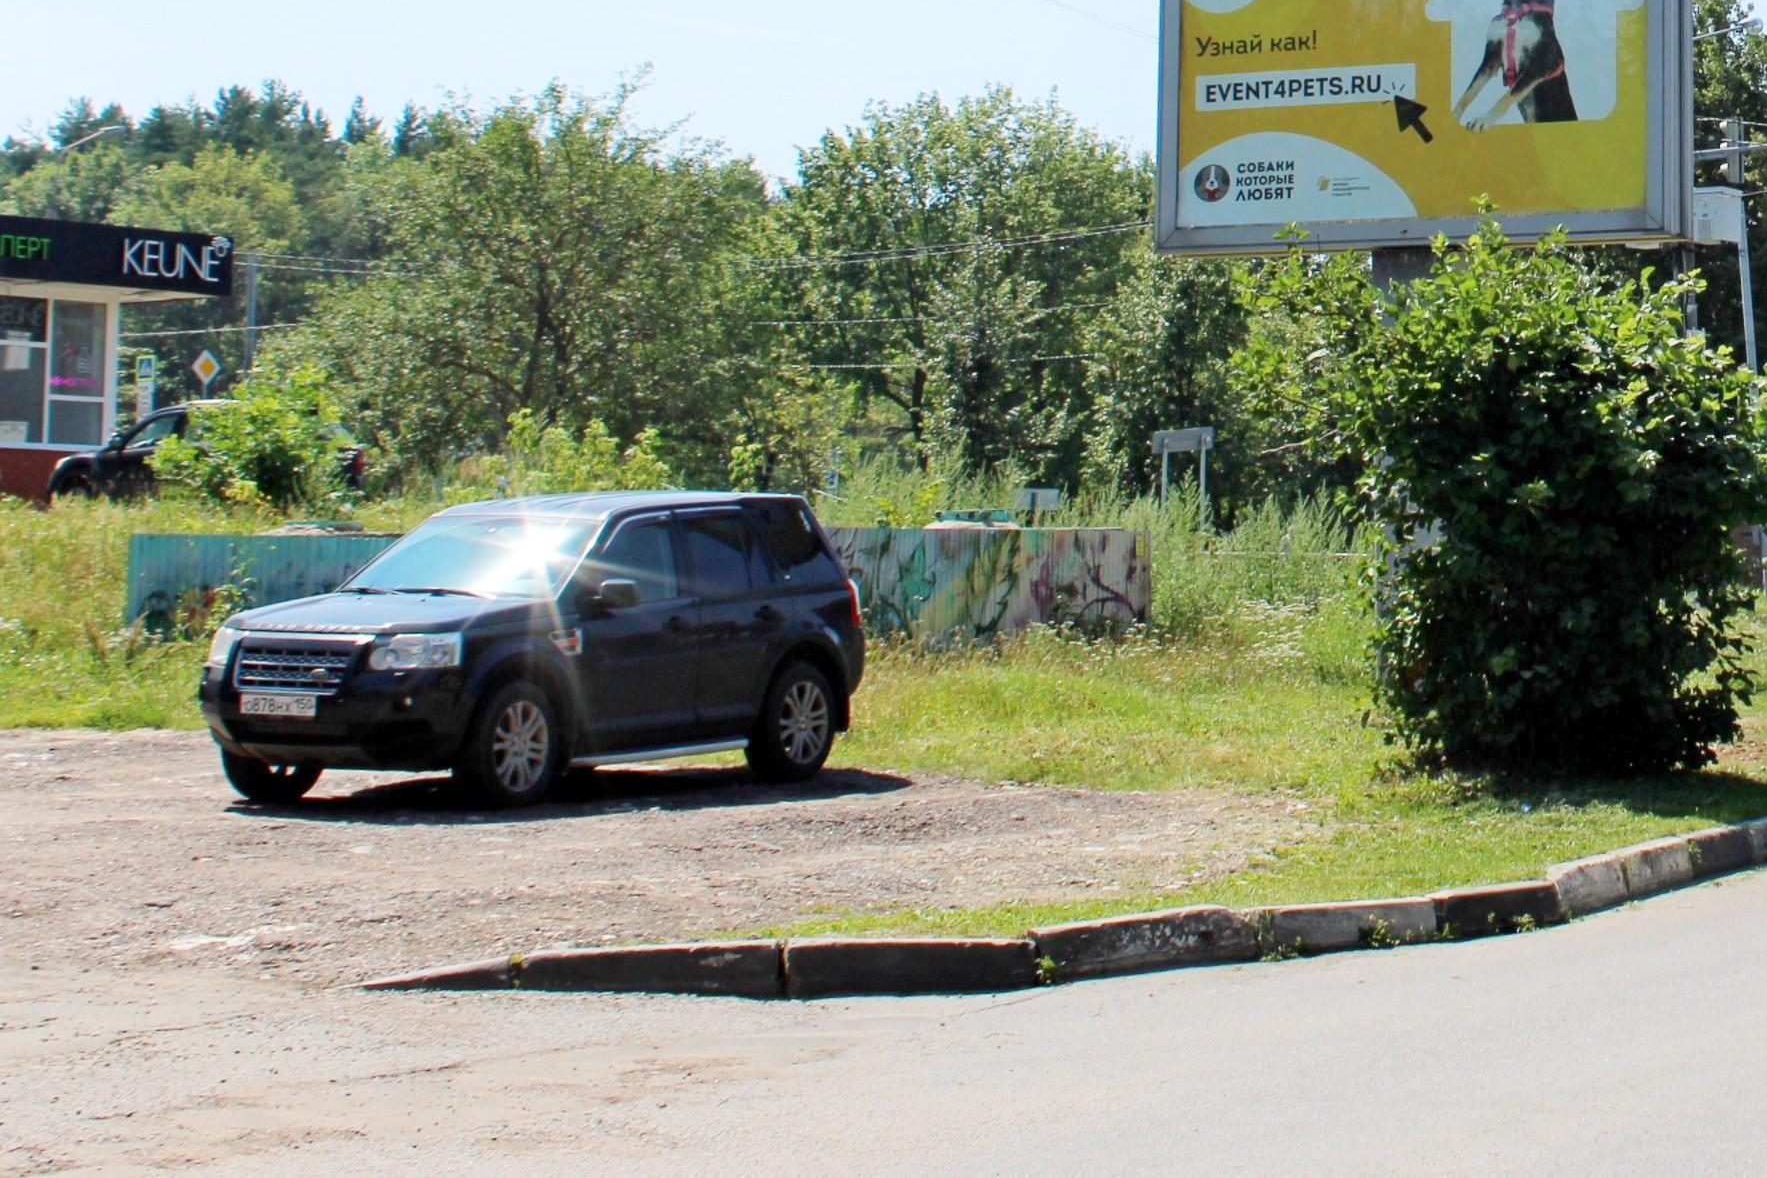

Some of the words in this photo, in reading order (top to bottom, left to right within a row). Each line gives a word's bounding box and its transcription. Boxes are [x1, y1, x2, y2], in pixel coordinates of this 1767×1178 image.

[1195, 34, 1263, 57] Узнай
[1270, 29, 1318, 53] как!
[1205, 74, 1382, 104] EVENT4PETS.RU
[1236, 160, 1295, 174] СОБАКИ
[1235, 173, 1295, 187] КОТОРЫЕ
[1234, 186, 1295, 202] ЛЮБЯТ
[122, 237, 220, 282] KEUNE
